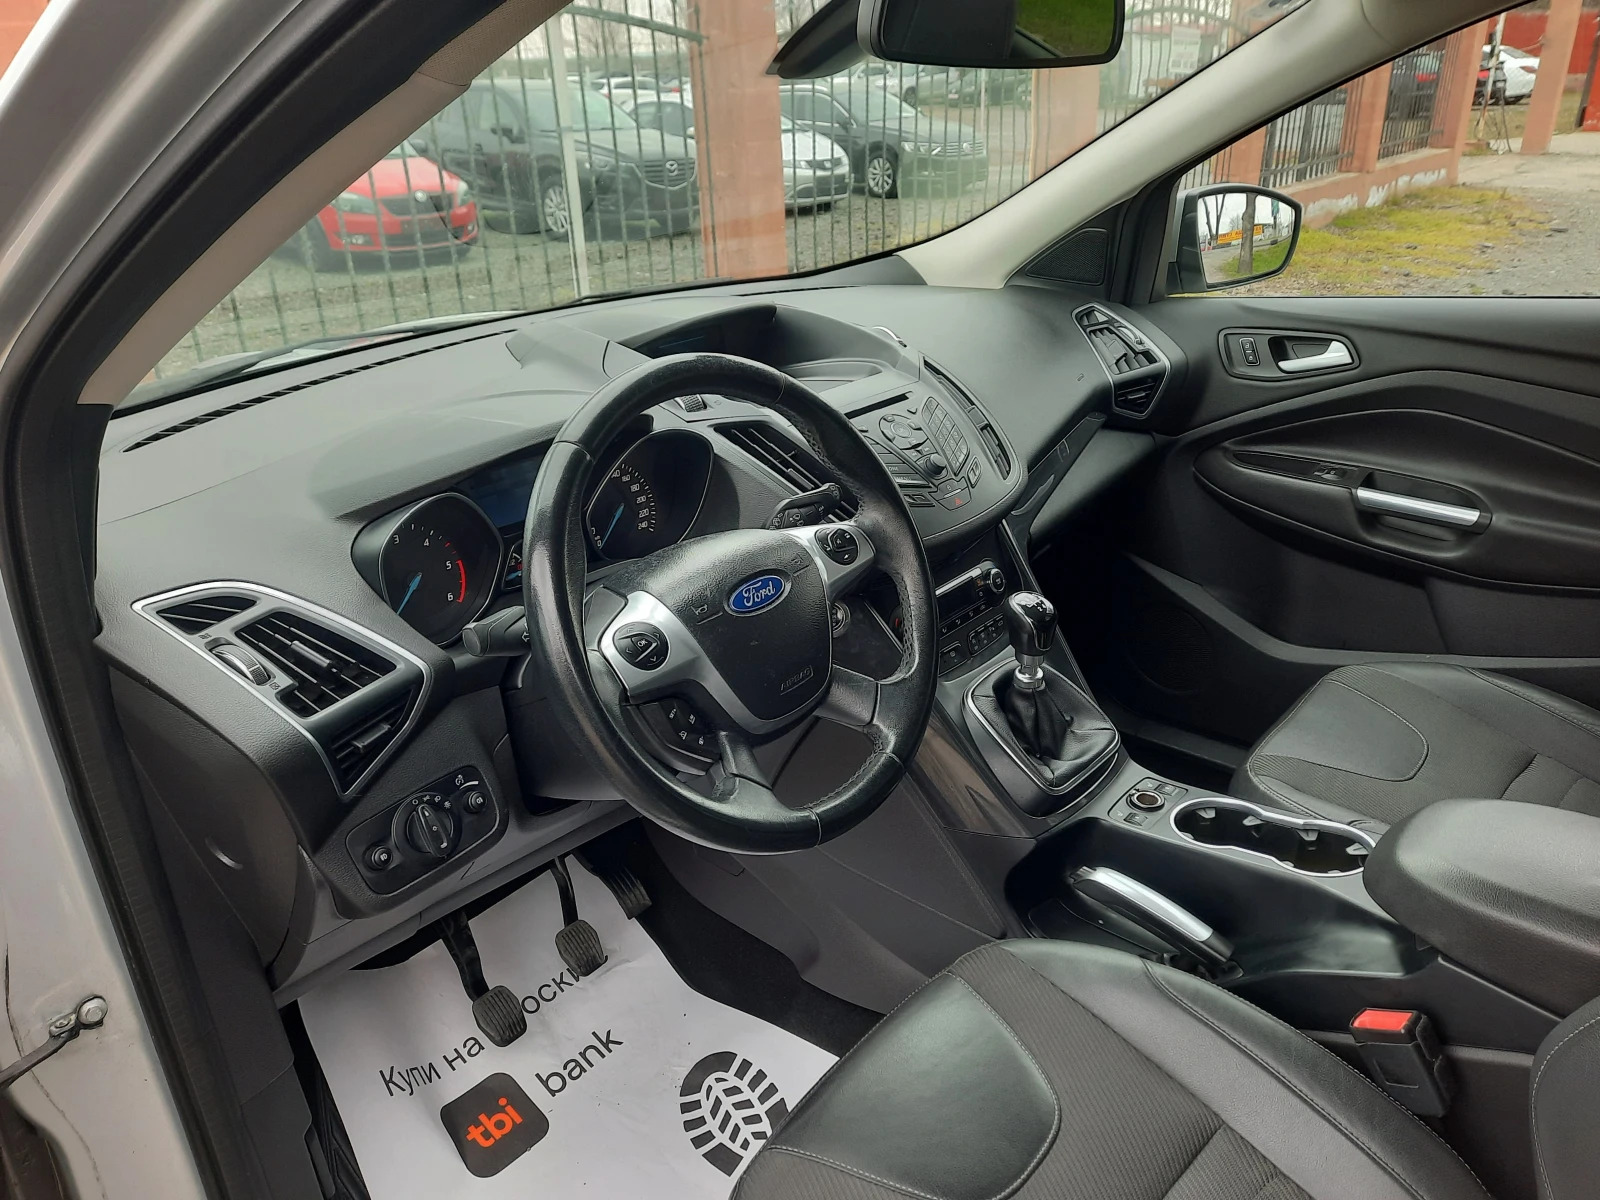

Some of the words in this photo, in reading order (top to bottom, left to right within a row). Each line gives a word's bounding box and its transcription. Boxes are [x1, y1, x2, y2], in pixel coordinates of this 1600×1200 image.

[636, 495, 647, 504] 200
[638, 508, 650, 518] 220
[637, 520, 648, 530] 240
[392, 534, 400, 545] 3
[423, 537, 430, 547] 4
[445, 560, 453, 570] 5
[446, 592, 454, 602] 6
[742, 580, 776, 607] Ford
[637, 638, 649, 647] OK
[379, 1062, 442, 1097] Купи
[442, 1036, 486, 1072] на
[465, 1096, 524, 1148] tbi
[534, 1028, 625, 1098] bank
